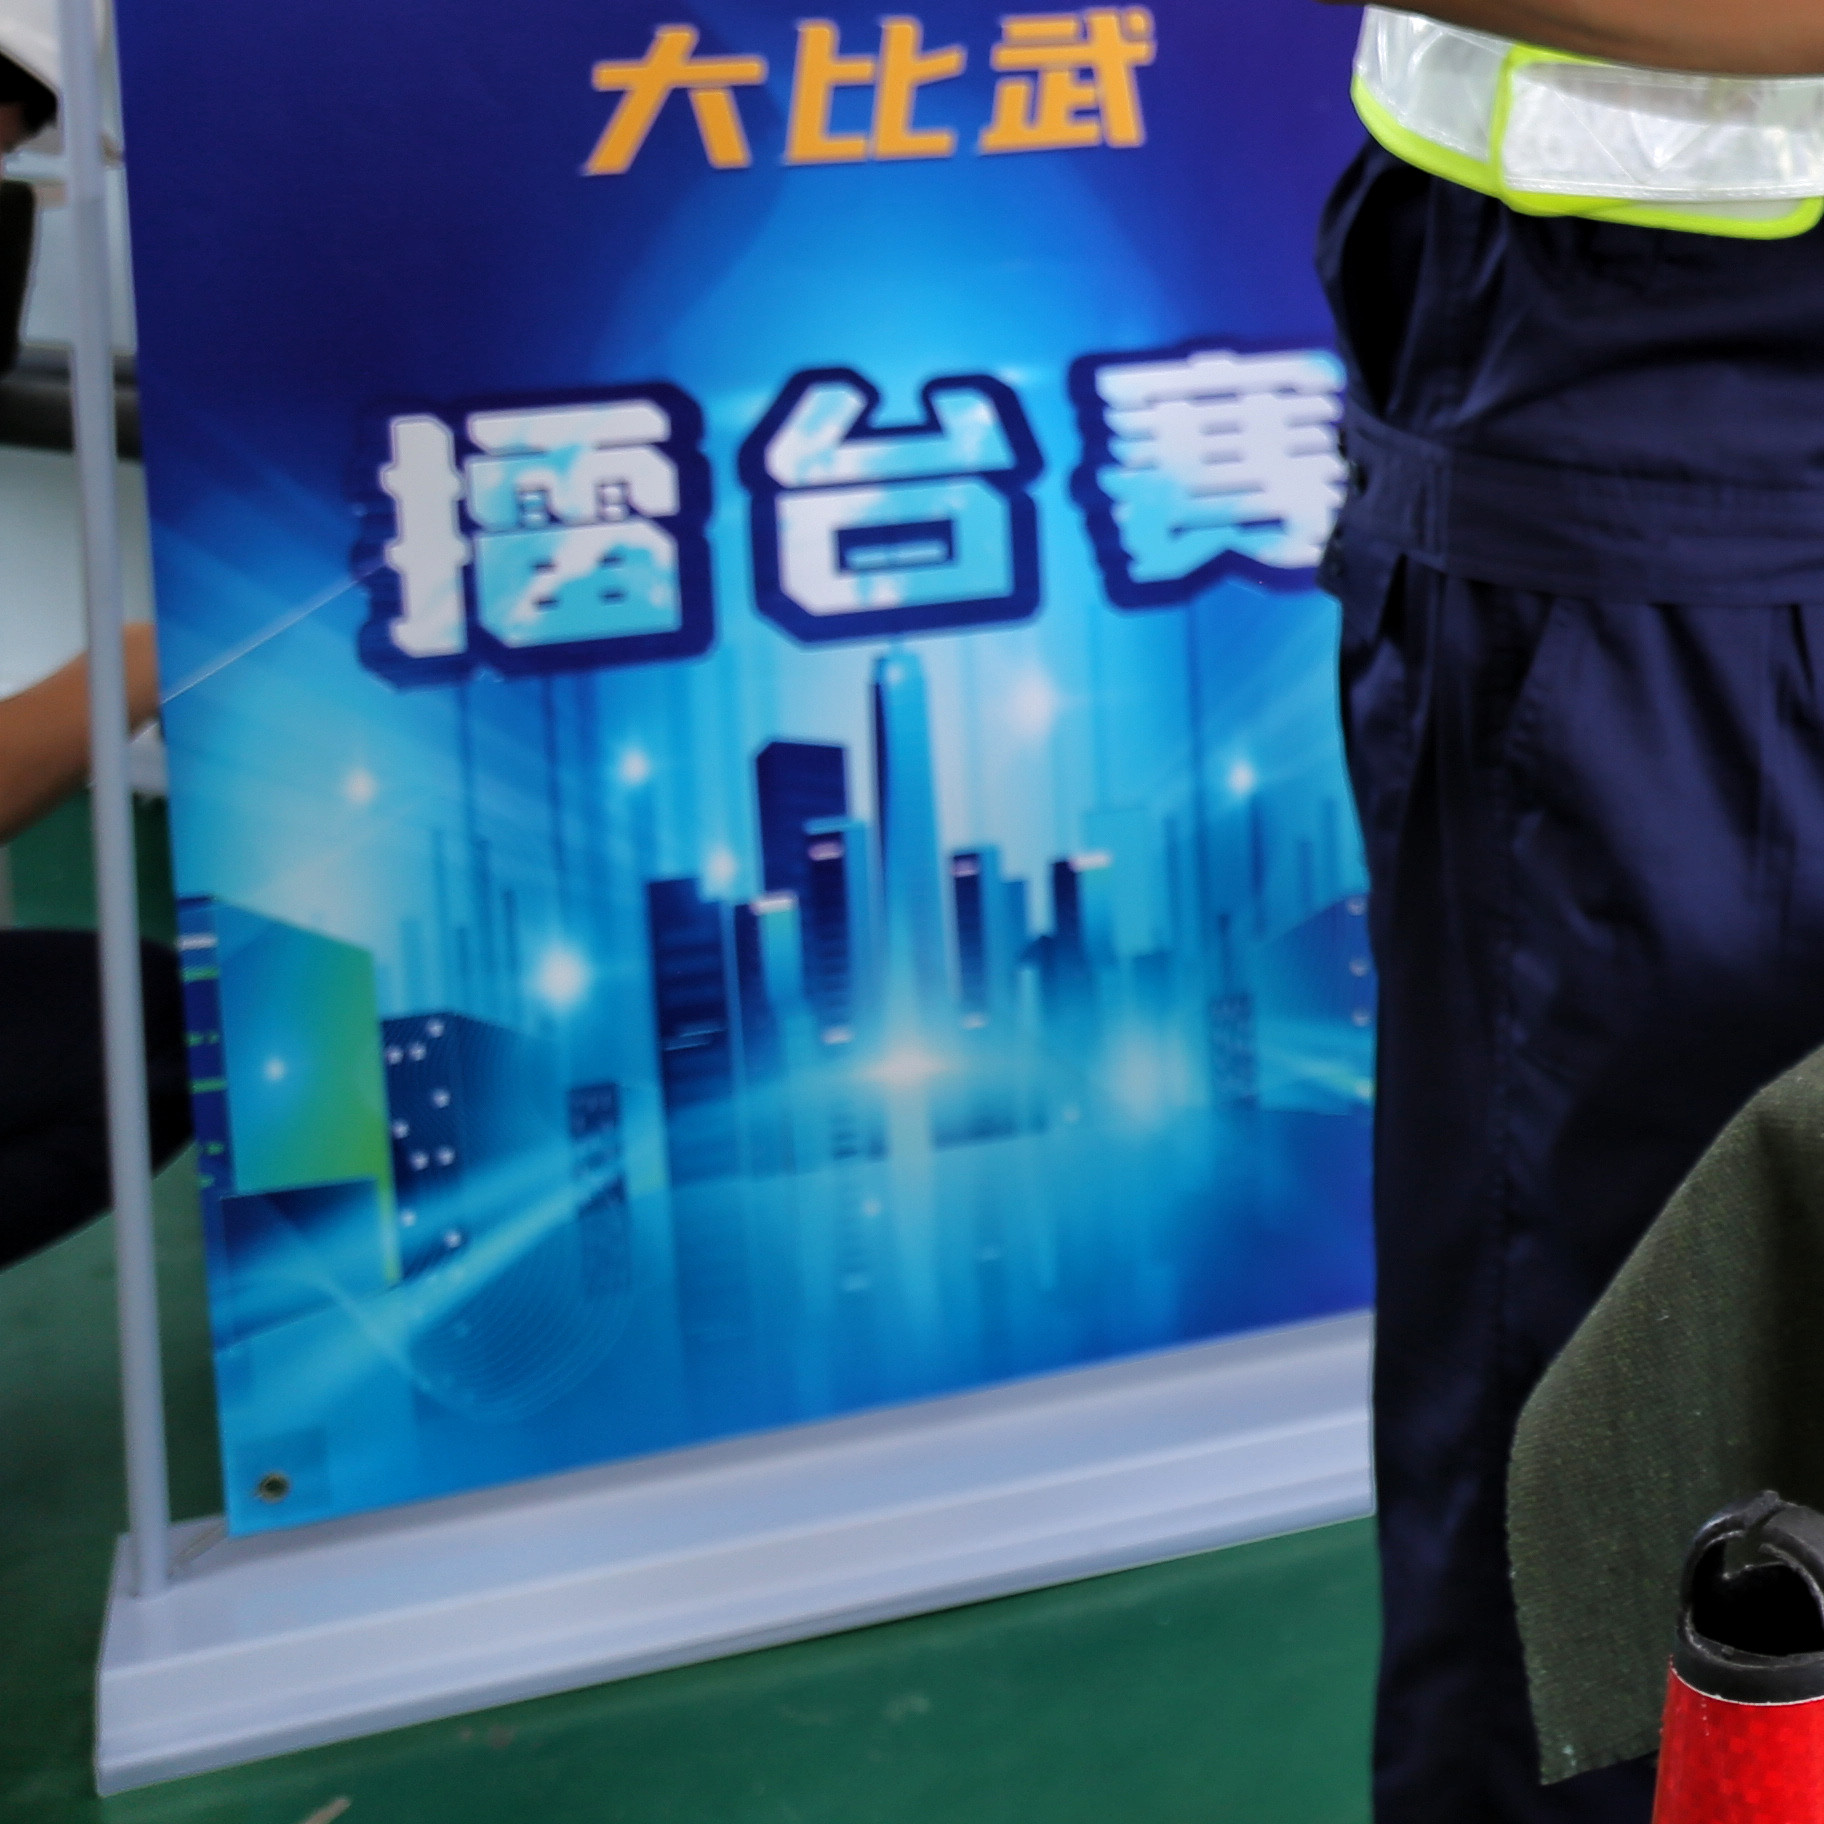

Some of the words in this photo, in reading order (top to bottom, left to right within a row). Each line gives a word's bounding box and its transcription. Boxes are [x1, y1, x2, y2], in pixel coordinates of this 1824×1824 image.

[585, 7, 1156, 175] 大比武
[370, 344, 1346, 670] 擂台赛
